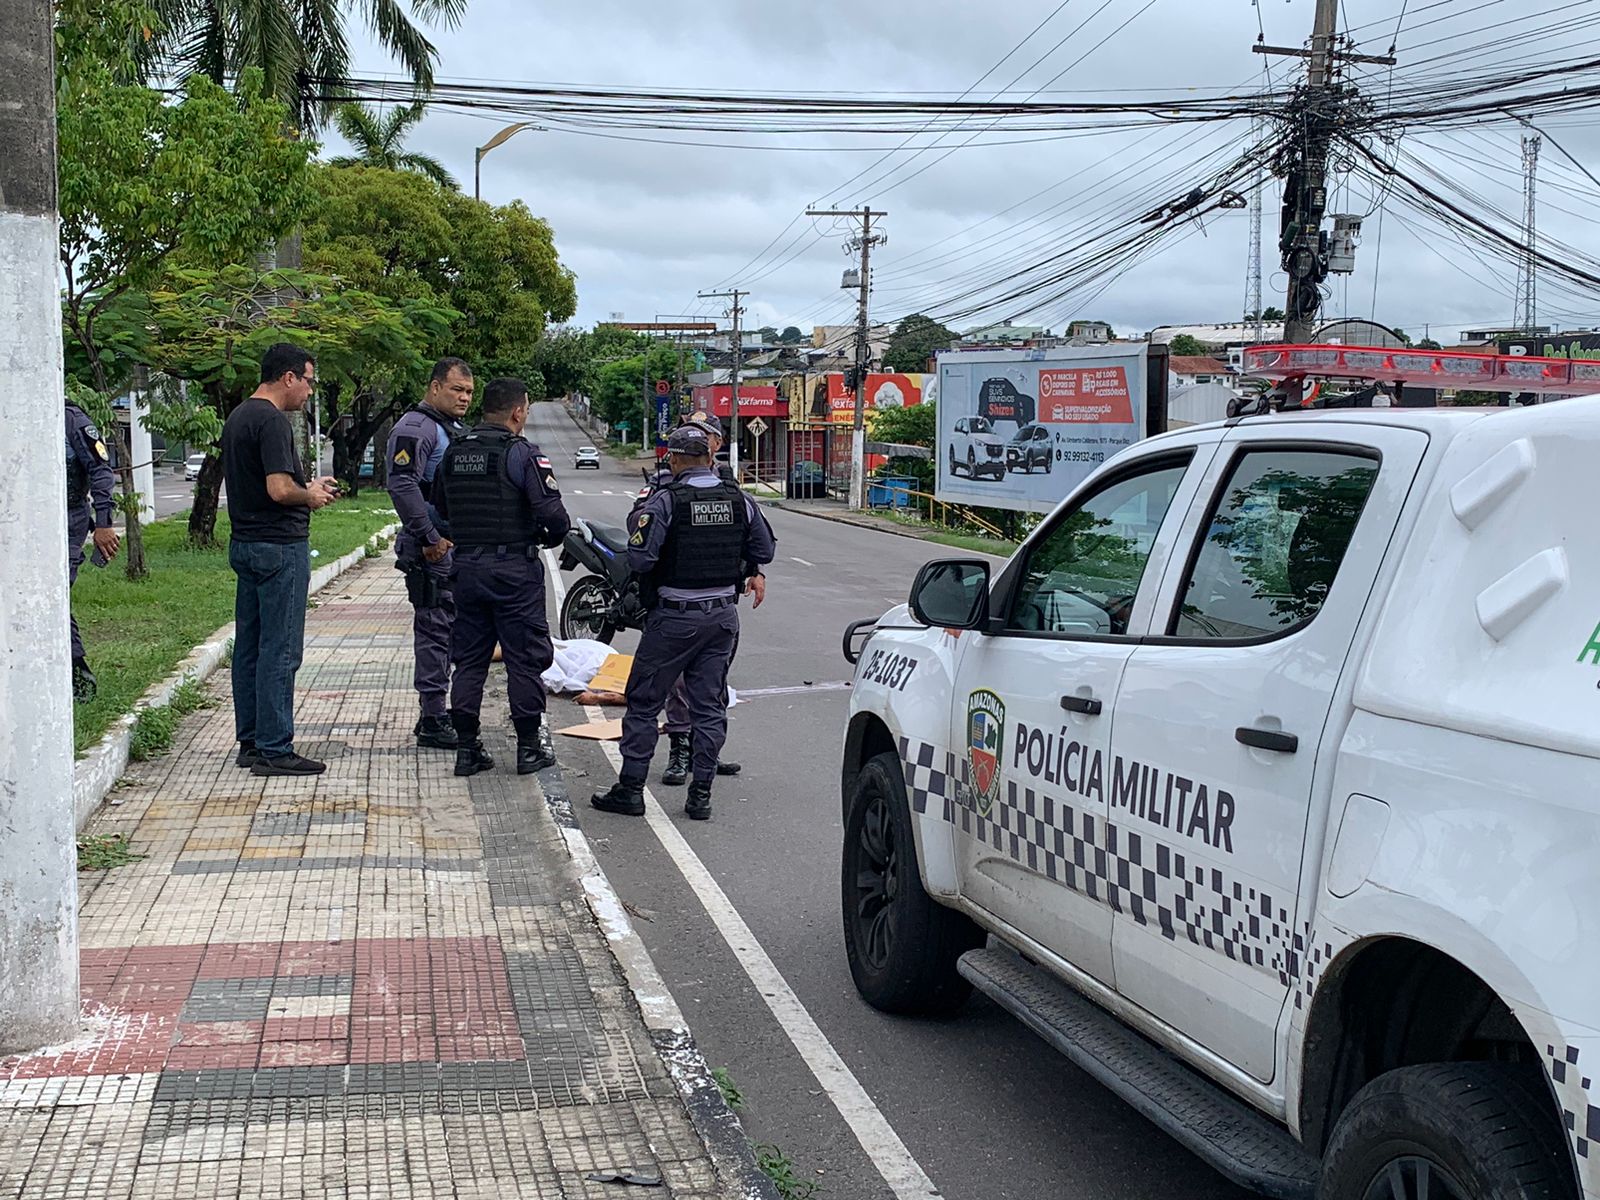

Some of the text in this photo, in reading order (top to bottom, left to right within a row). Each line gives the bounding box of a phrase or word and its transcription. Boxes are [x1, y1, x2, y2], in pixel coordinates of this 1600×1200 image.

[454, 454, 485, 463] POLÍCIA
[1063, 450, 1072, 461] 92
[454, 463, 485, 472] MILITAR
[694, 502, 730, 514] POLÍCIA
[695, 513, 731, 523] MILITAR
[862, 649, 918, 691] 25-1037
[969, 692, 1004, 725] AMAZONAS
[1013, 722, 1104, 803] POLÍCIA
[1110, 755, 1236, 855] MILITAR
